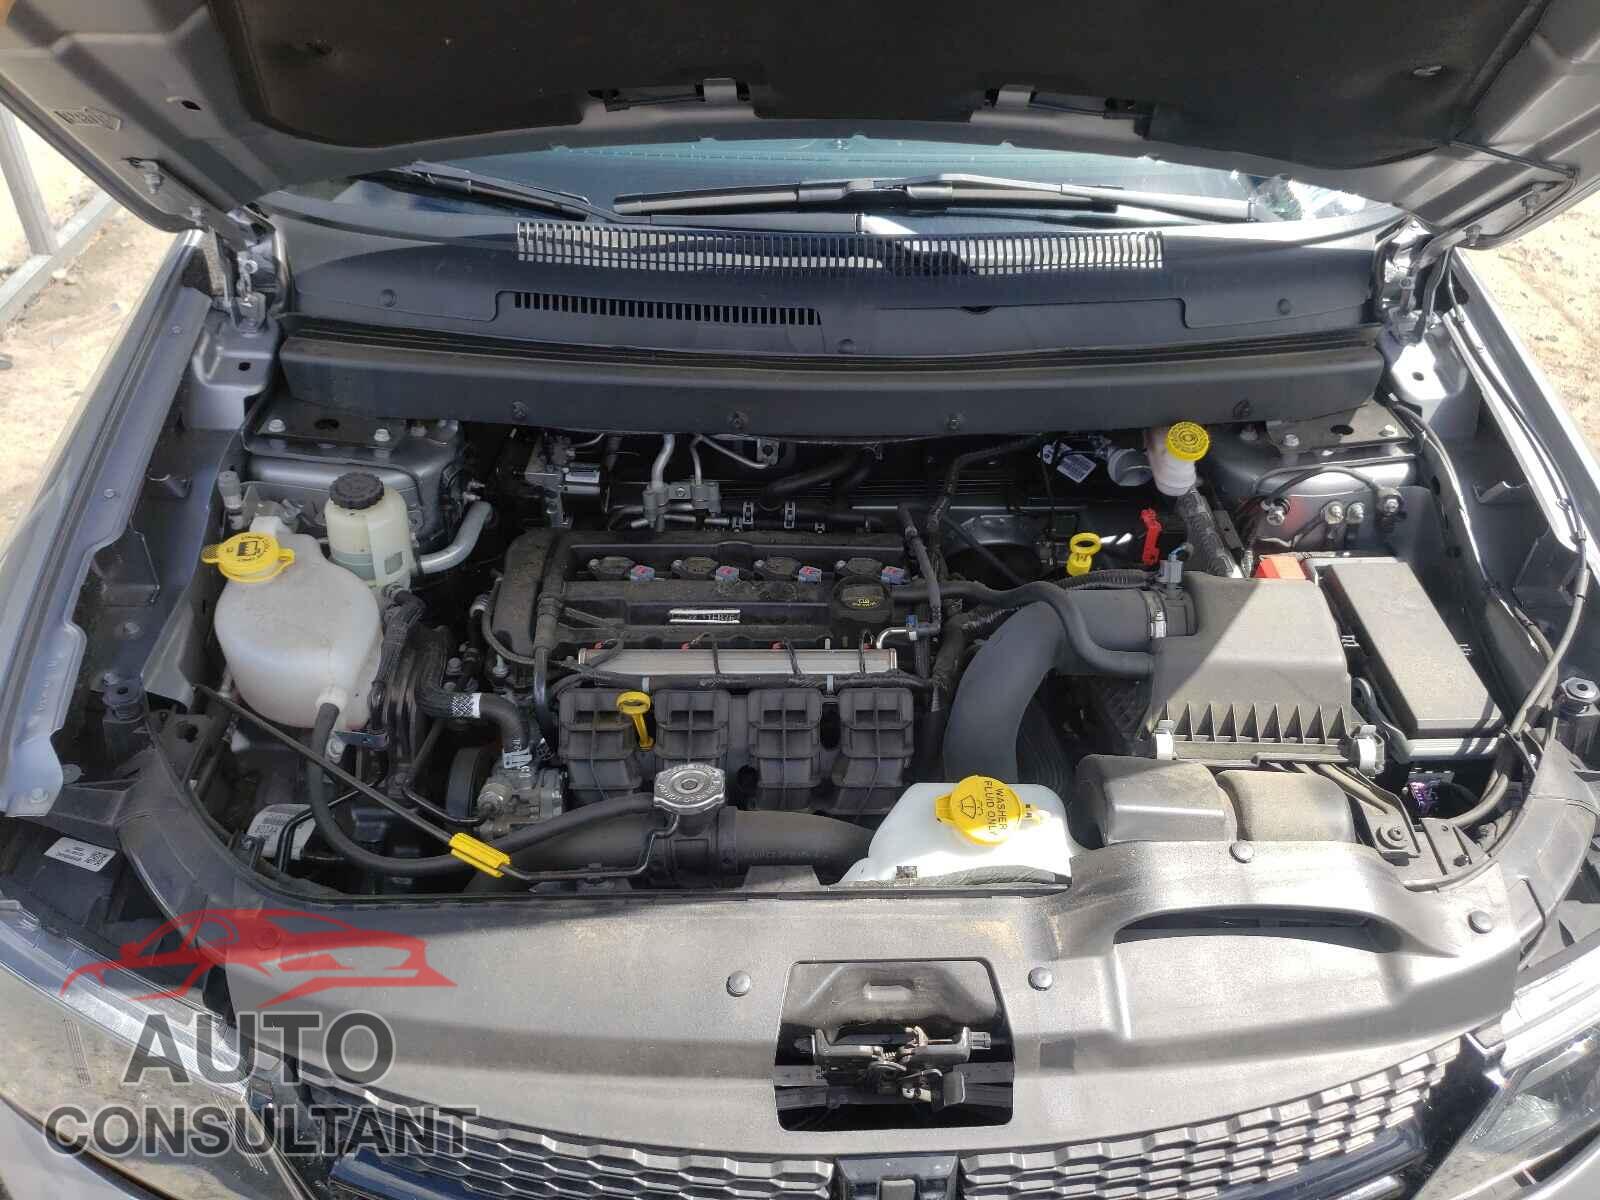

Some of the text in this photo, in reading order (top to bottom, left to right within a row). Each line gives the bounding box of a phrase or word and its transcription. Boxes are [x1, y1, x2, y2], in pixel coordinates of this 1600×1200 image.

[984, 780, 998, 836] FLUID ONLY
[995, 788, 1007, 830] WASHER
